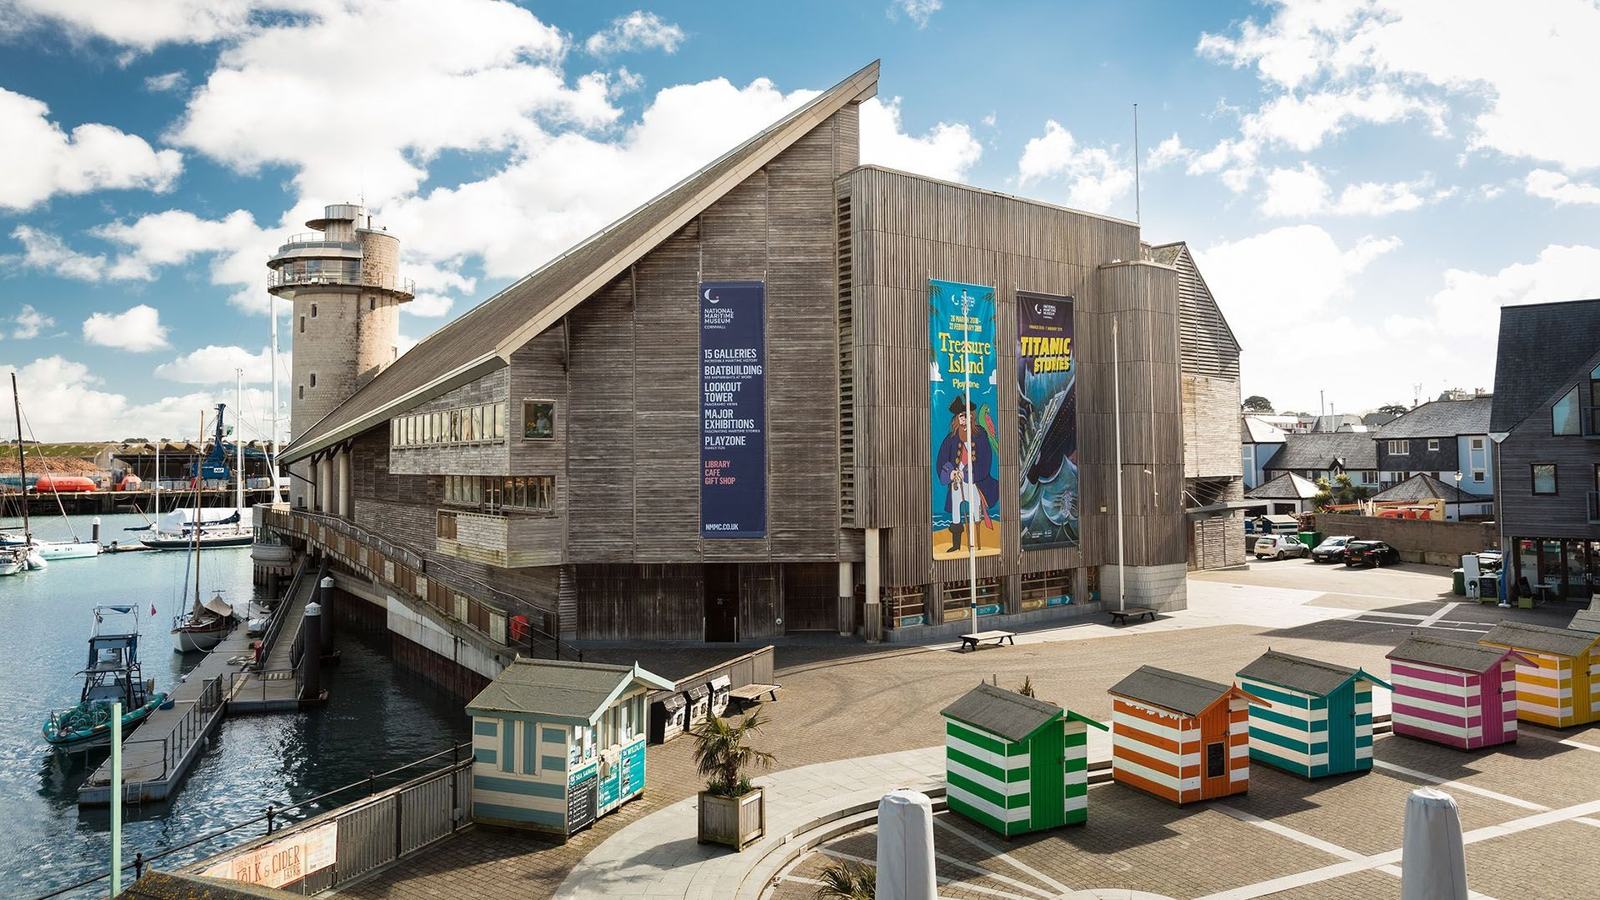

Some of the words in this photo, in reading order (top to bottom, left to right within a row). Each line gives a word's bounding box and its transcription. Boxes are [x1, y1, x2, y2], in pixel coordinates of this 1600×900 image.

[938, 332, 991, 355] Treasure
[1021, 336, 1071, 356] TITANIC
[704, 349, 712, 359] 15
[714, 348, 757, 359] GALLERIES
[948, 353, 984, 374] Islnd
[1034, 356, 1070, 373] STORIES
[704, 365, 762, 375] BOATBUILDING
[704, 382, 741, 392] LOOKOUT
[952, 378, 980, 390] Playone
[704, 392, 733, 402] TOWER
[704, 409, 734, 419] MAJOR
[704, 419, 755, 429] EXHIBITIONS
[704, 436, 746, 446] PLAYZONE
[720, 477, 736, 485] SHOP
[272, 845, 301, 873] CIDER
